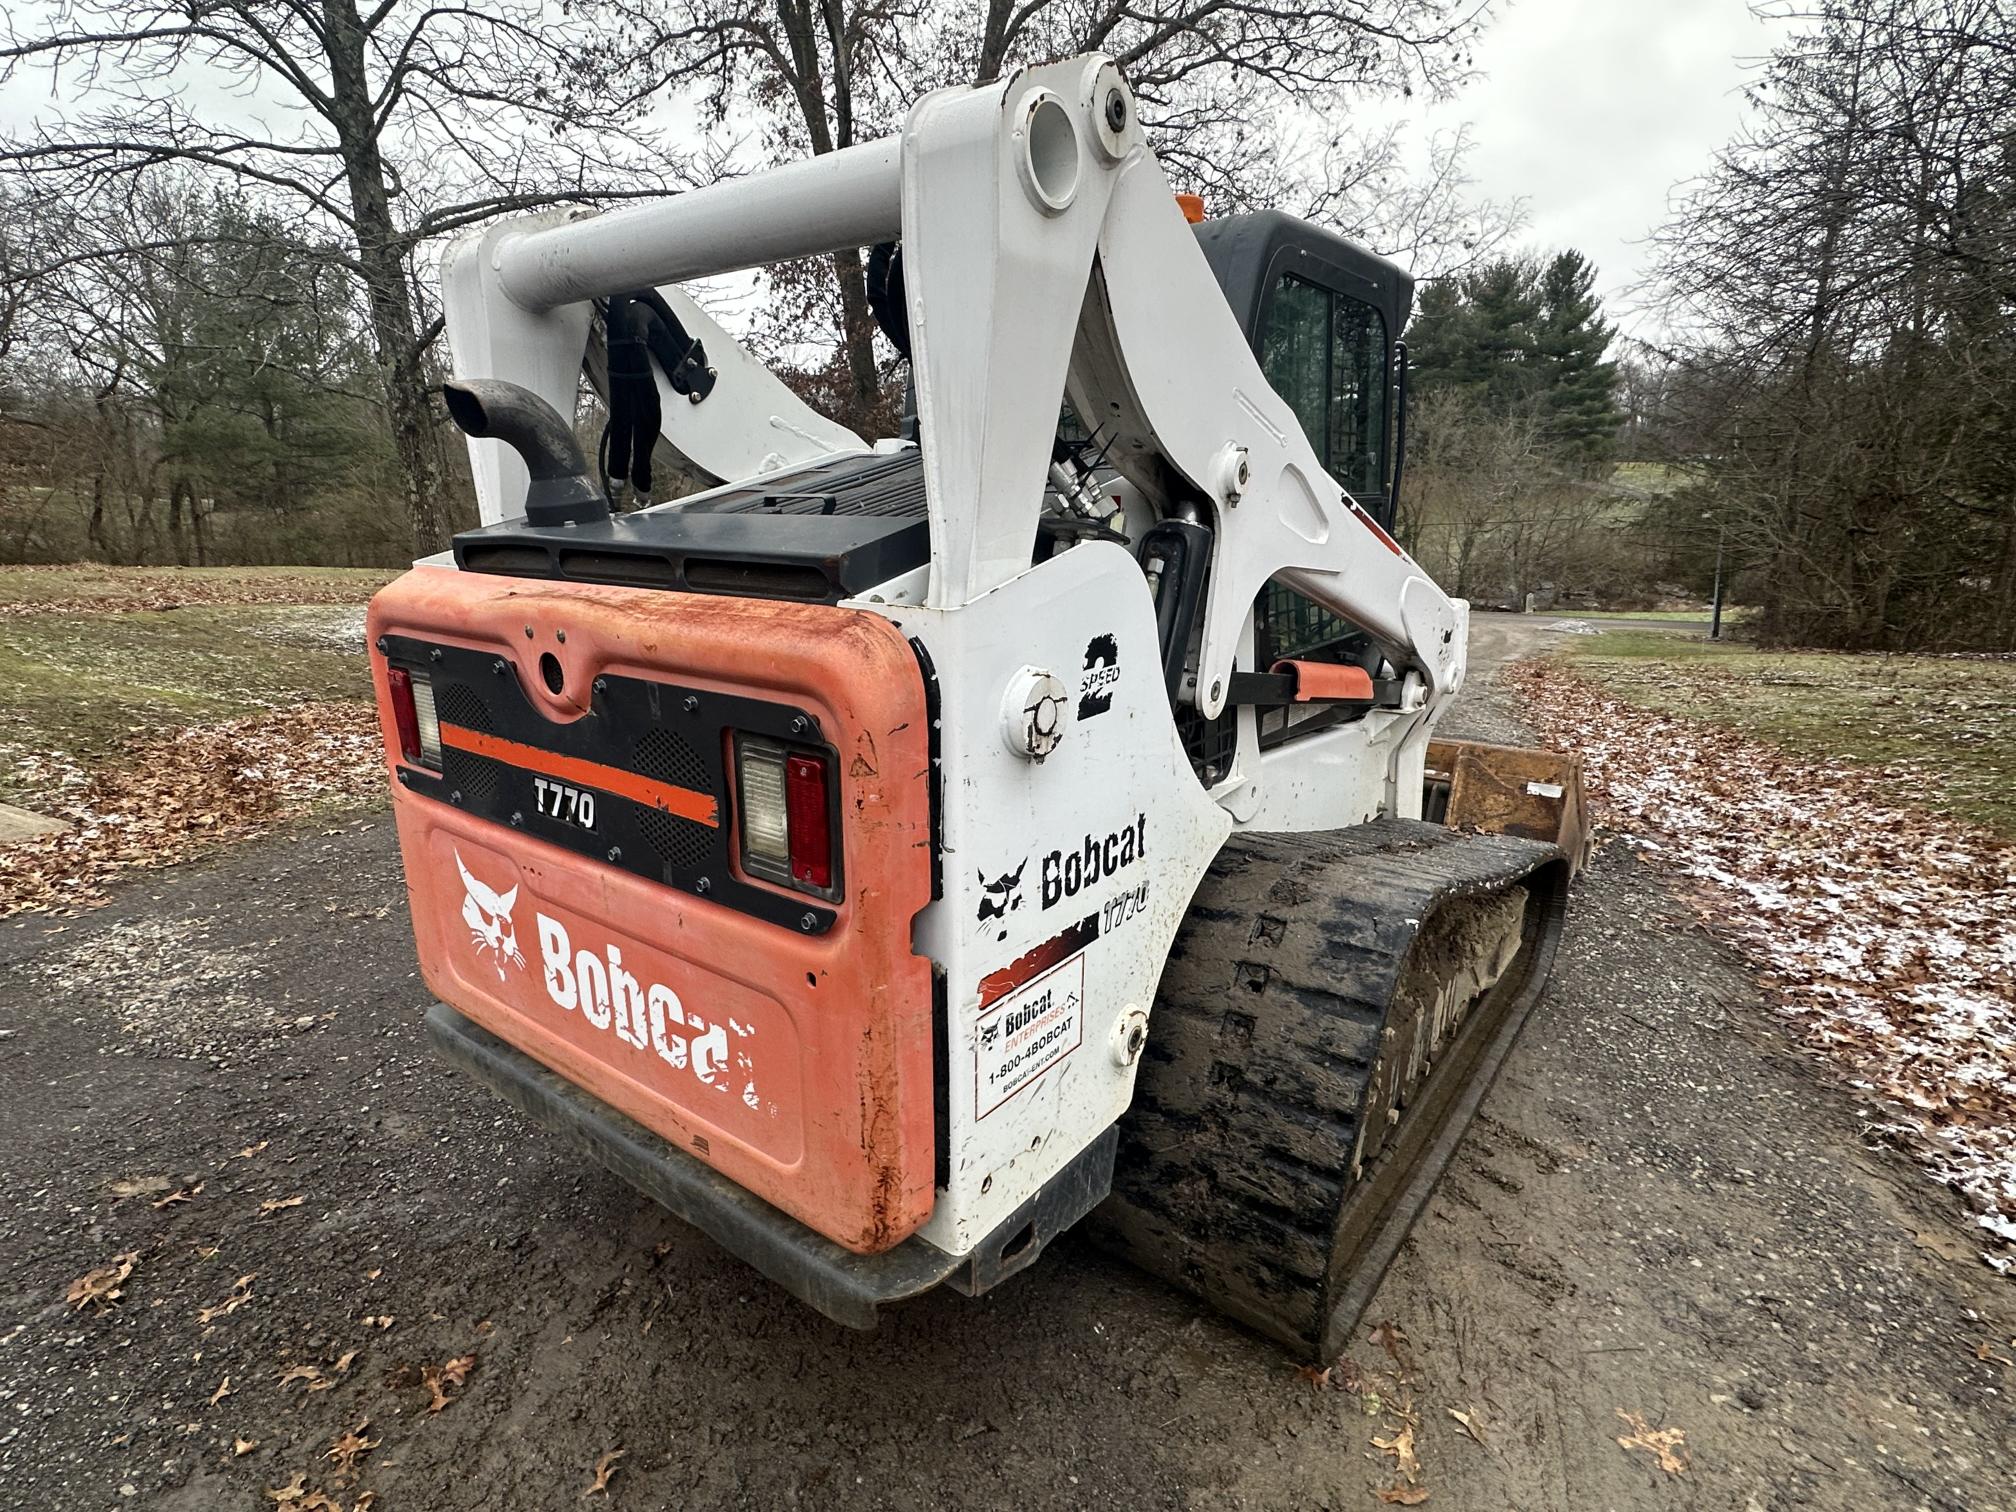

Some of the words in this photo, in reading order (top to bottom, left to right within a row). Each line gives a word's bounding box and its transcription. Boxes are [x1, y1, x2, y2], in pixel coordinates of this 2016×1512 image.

[534, 777, 595, 829] T770
[1042, 812, 1146, 911] Bobcat
[1005, 988, 1053, 1038] Bobcat
[1005, 1002, 1066, 1053] ENTERPRISES
[989, 1016, 1073, 1085] 1-800-4BOBCAT
